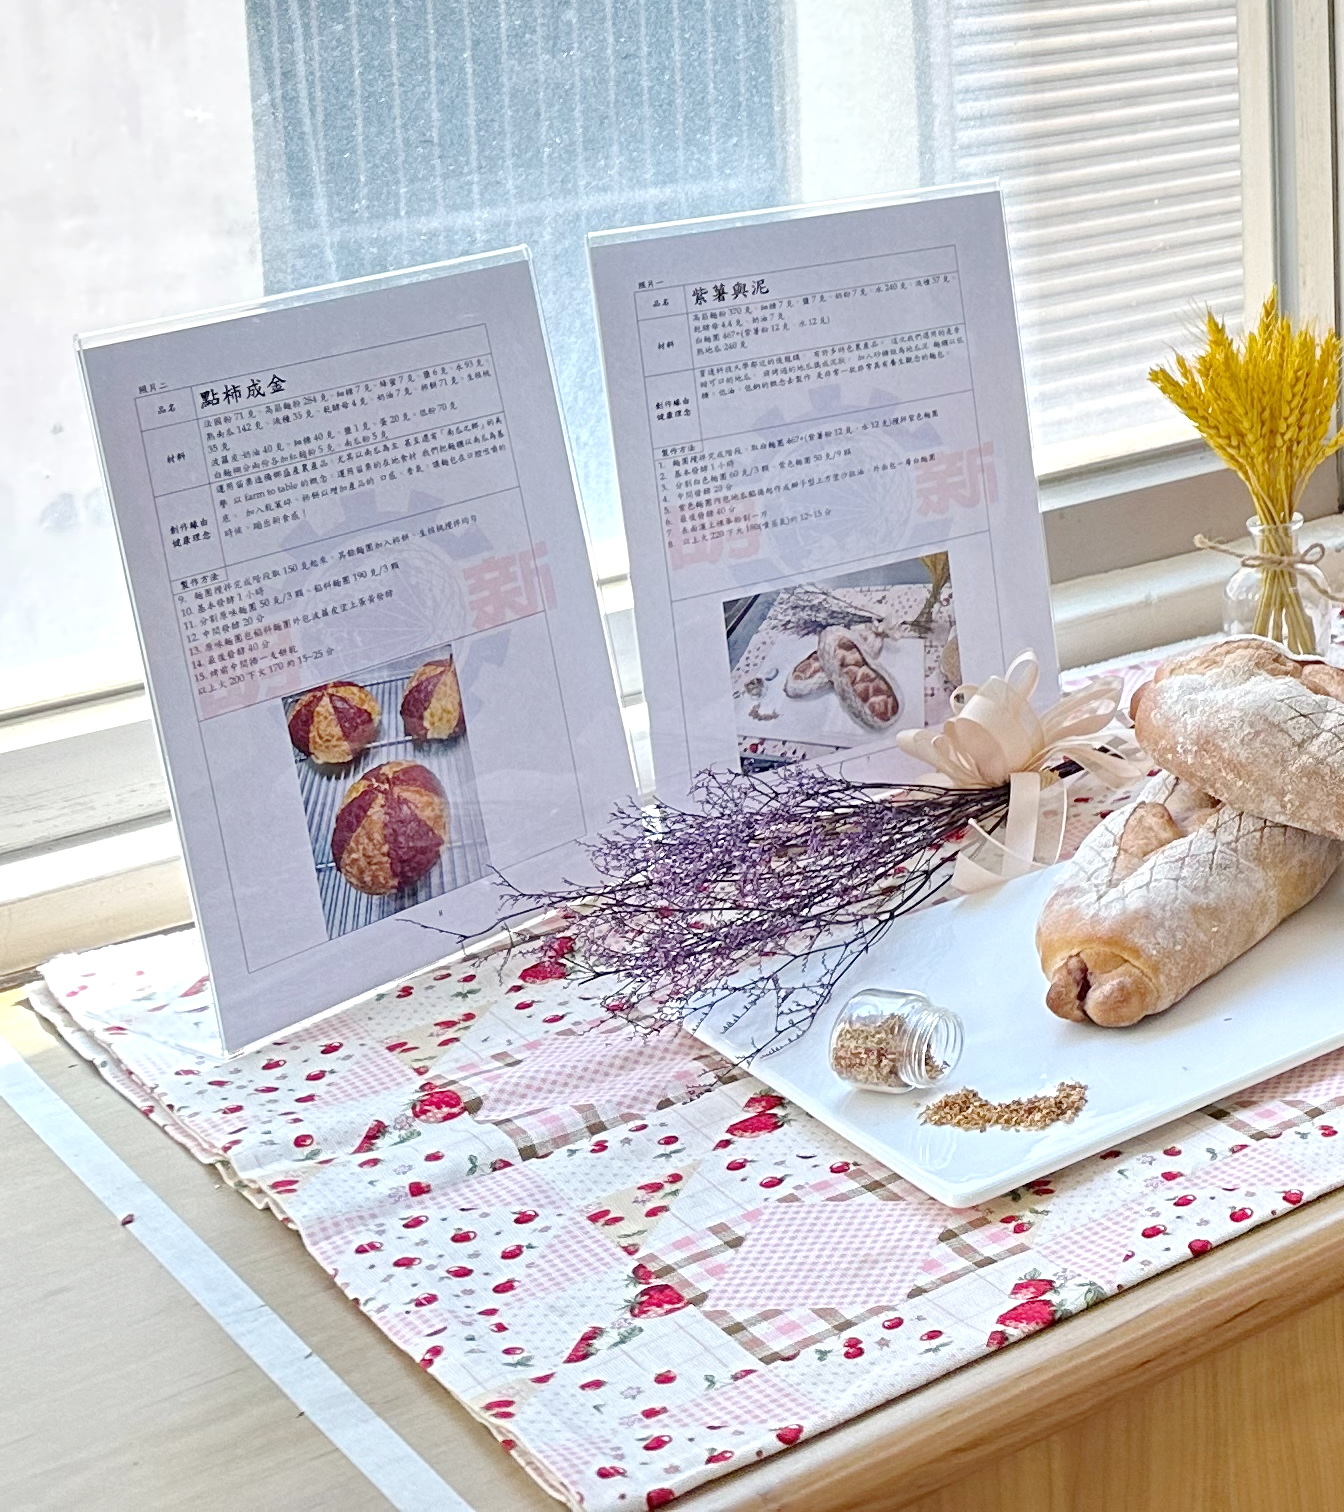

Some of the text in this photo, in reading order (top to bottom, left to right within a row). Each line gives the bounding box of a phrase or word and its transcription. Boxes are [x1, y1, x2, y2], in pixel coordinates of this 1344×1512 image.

[691, 278, 770, 306] 紫薯與泥
[198, 373, 286, 409] 點柿成金
[156, 402, 176, 415] 品名
[165, 450, 186, 464] 材料
[243, 490, 266, 502] farm
[276, 480, 298, 494] table
